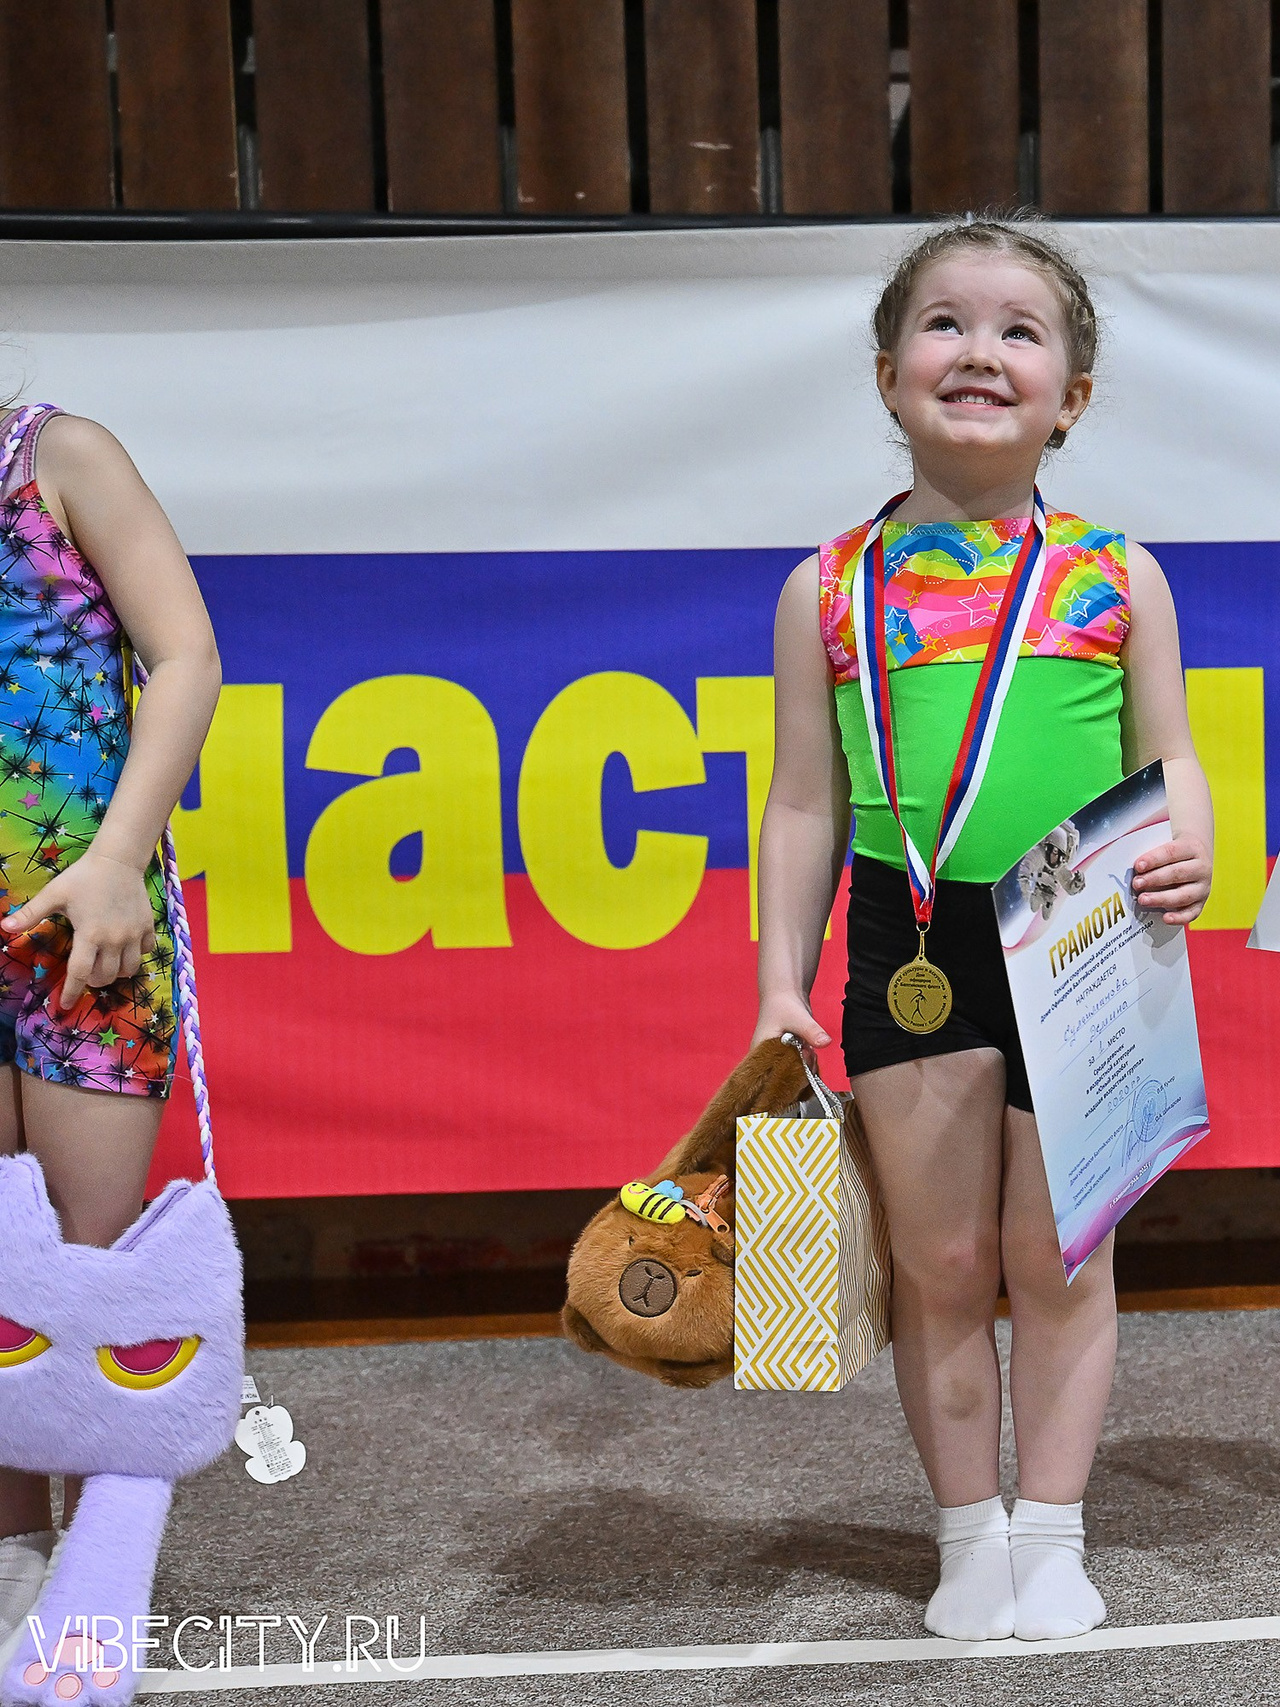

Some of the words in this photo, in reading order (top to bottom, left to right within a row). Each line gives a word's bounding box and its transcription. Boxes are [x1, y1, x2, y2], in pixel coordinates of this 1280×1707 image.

[1048, 891, 1126, 978] ГРАМОТА
[1069, 954, 1095, 981] спортивной
[1095, 933, 1122, 958] акробатики
[1072, 962, 1100, 989] Балтийского
[1076, 964, 1117, 1005] НАГРАЖДАЕТСЯ
[1088, 1056, 1095, 1067] за
[1107, 1027, 1125, 1047] место
